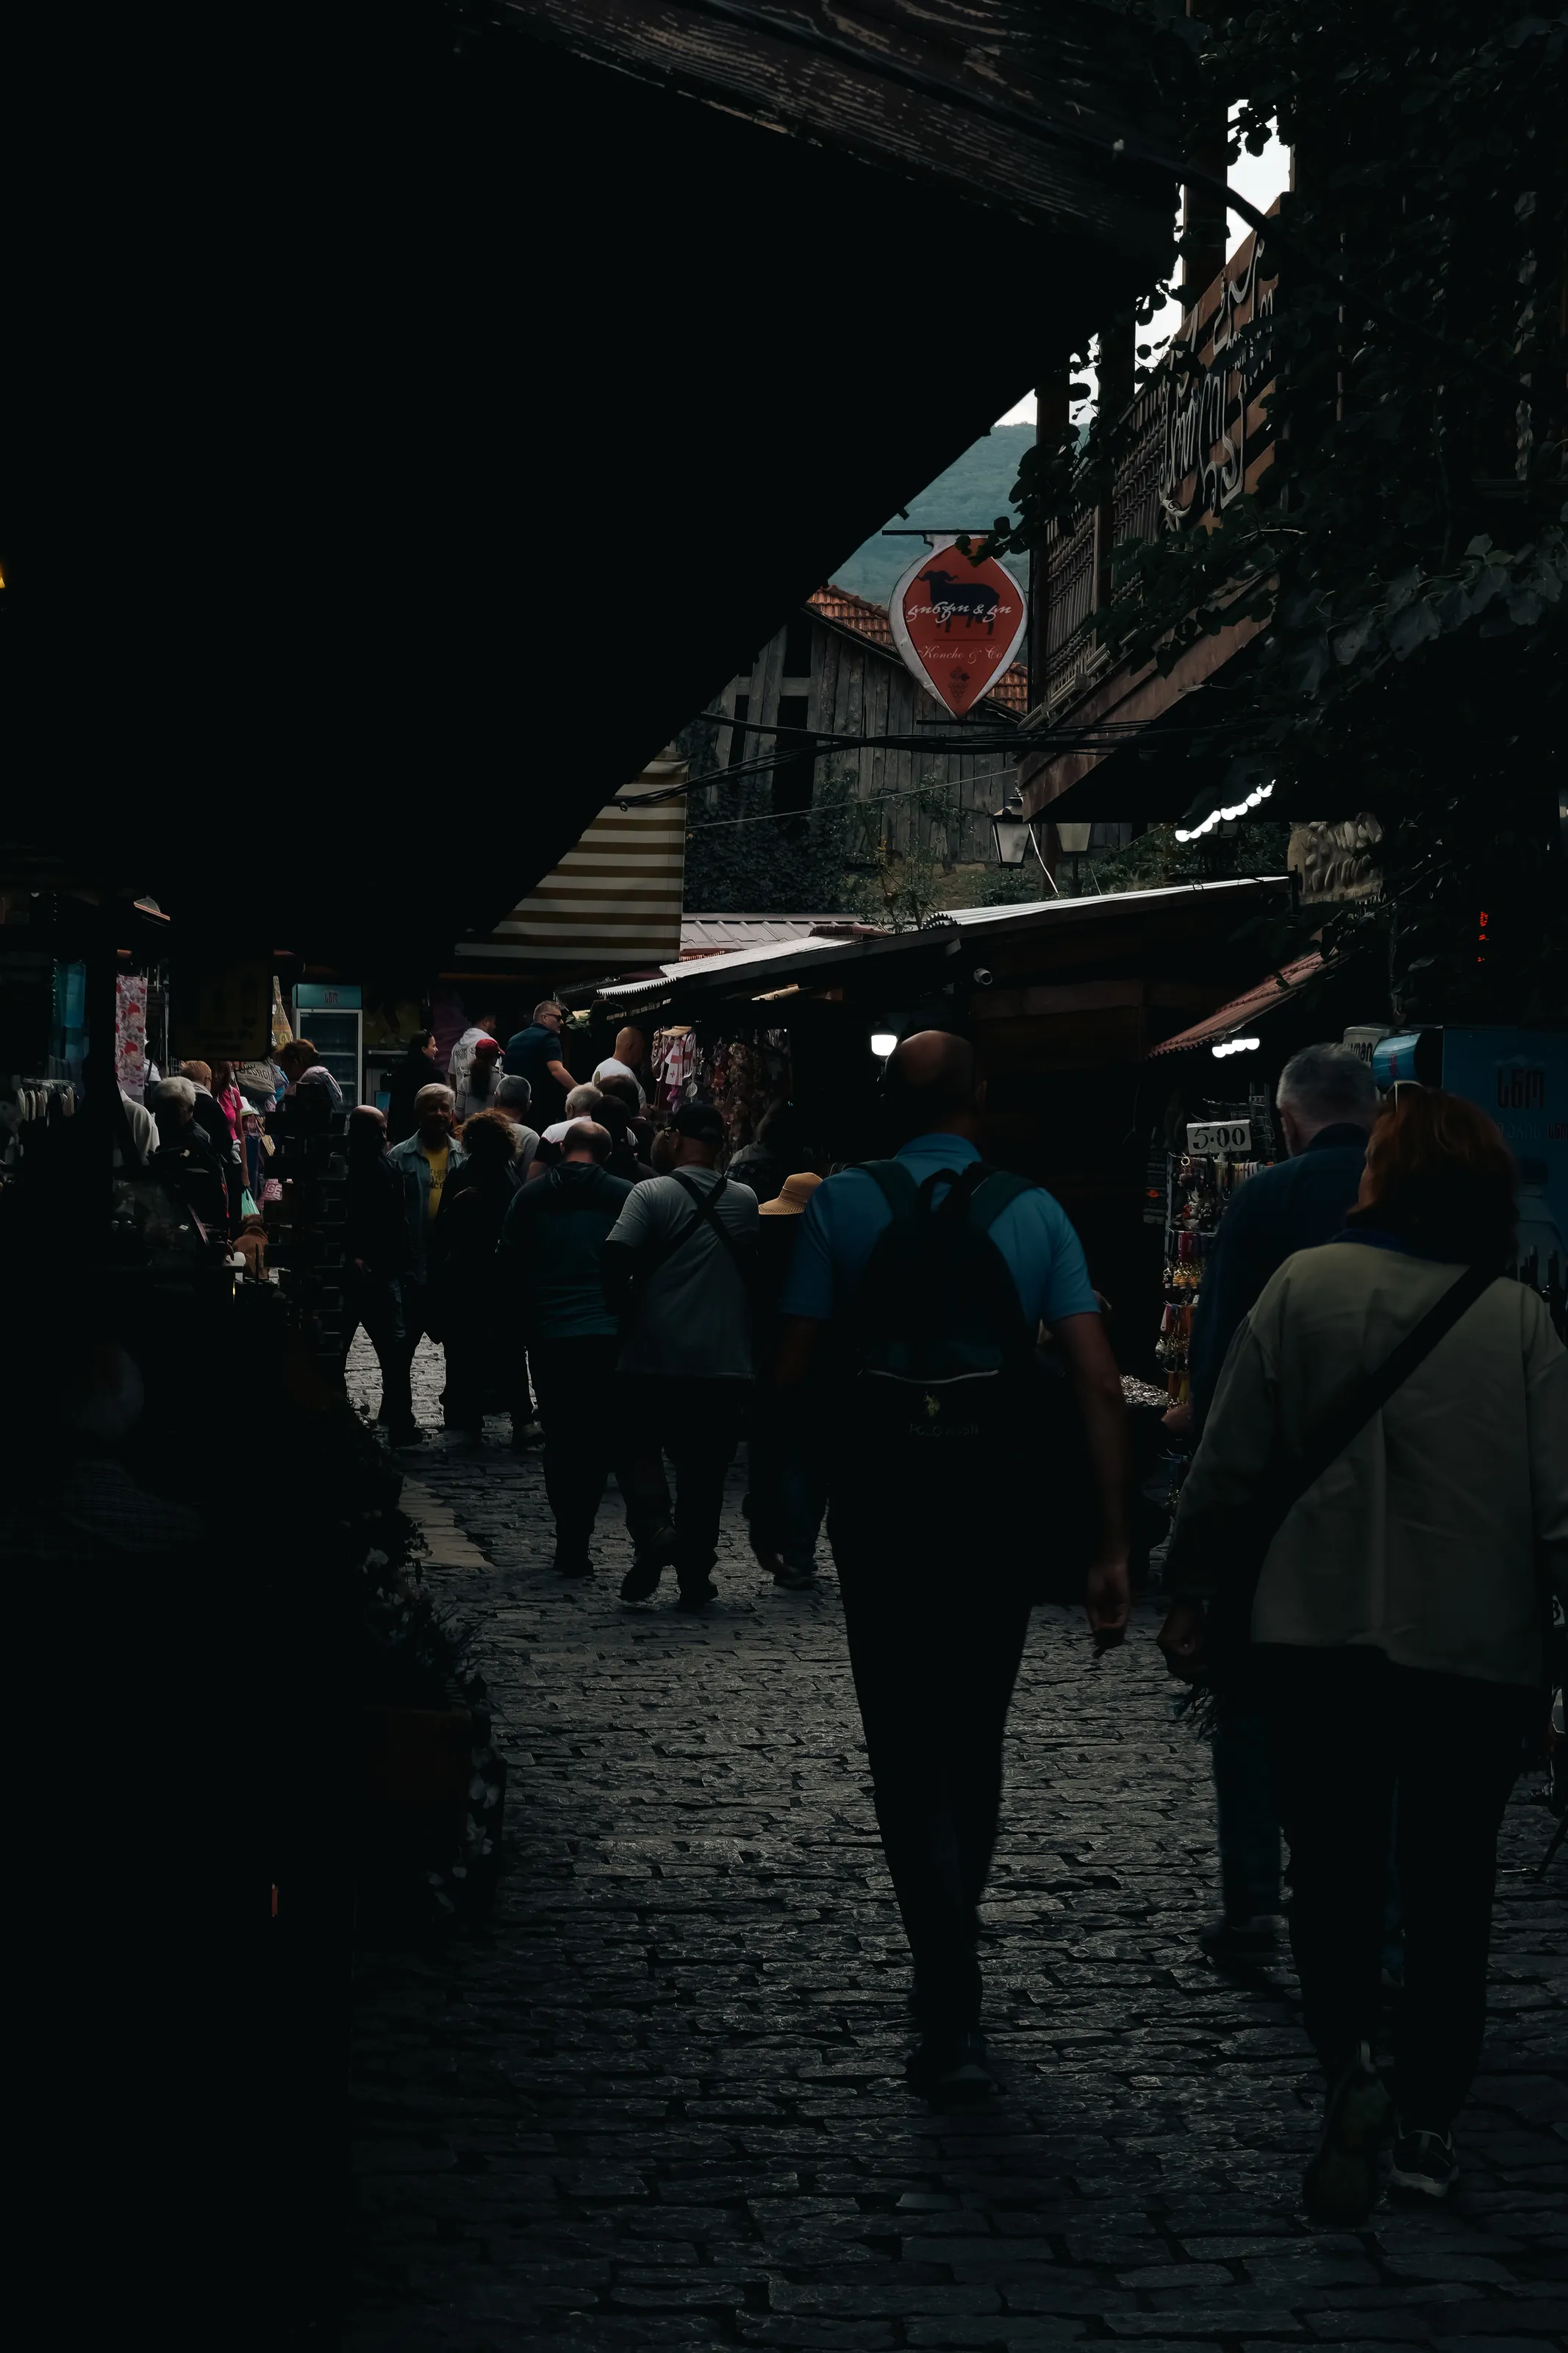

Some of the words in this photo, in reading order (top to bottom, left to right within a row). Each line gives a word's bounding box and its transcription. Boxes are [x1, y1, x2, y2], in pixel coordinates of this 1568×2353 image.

[973, 604, 984, 615] &
[917, 645, 964, 659] Koncho
[985, 645, 1002, 659] Co
